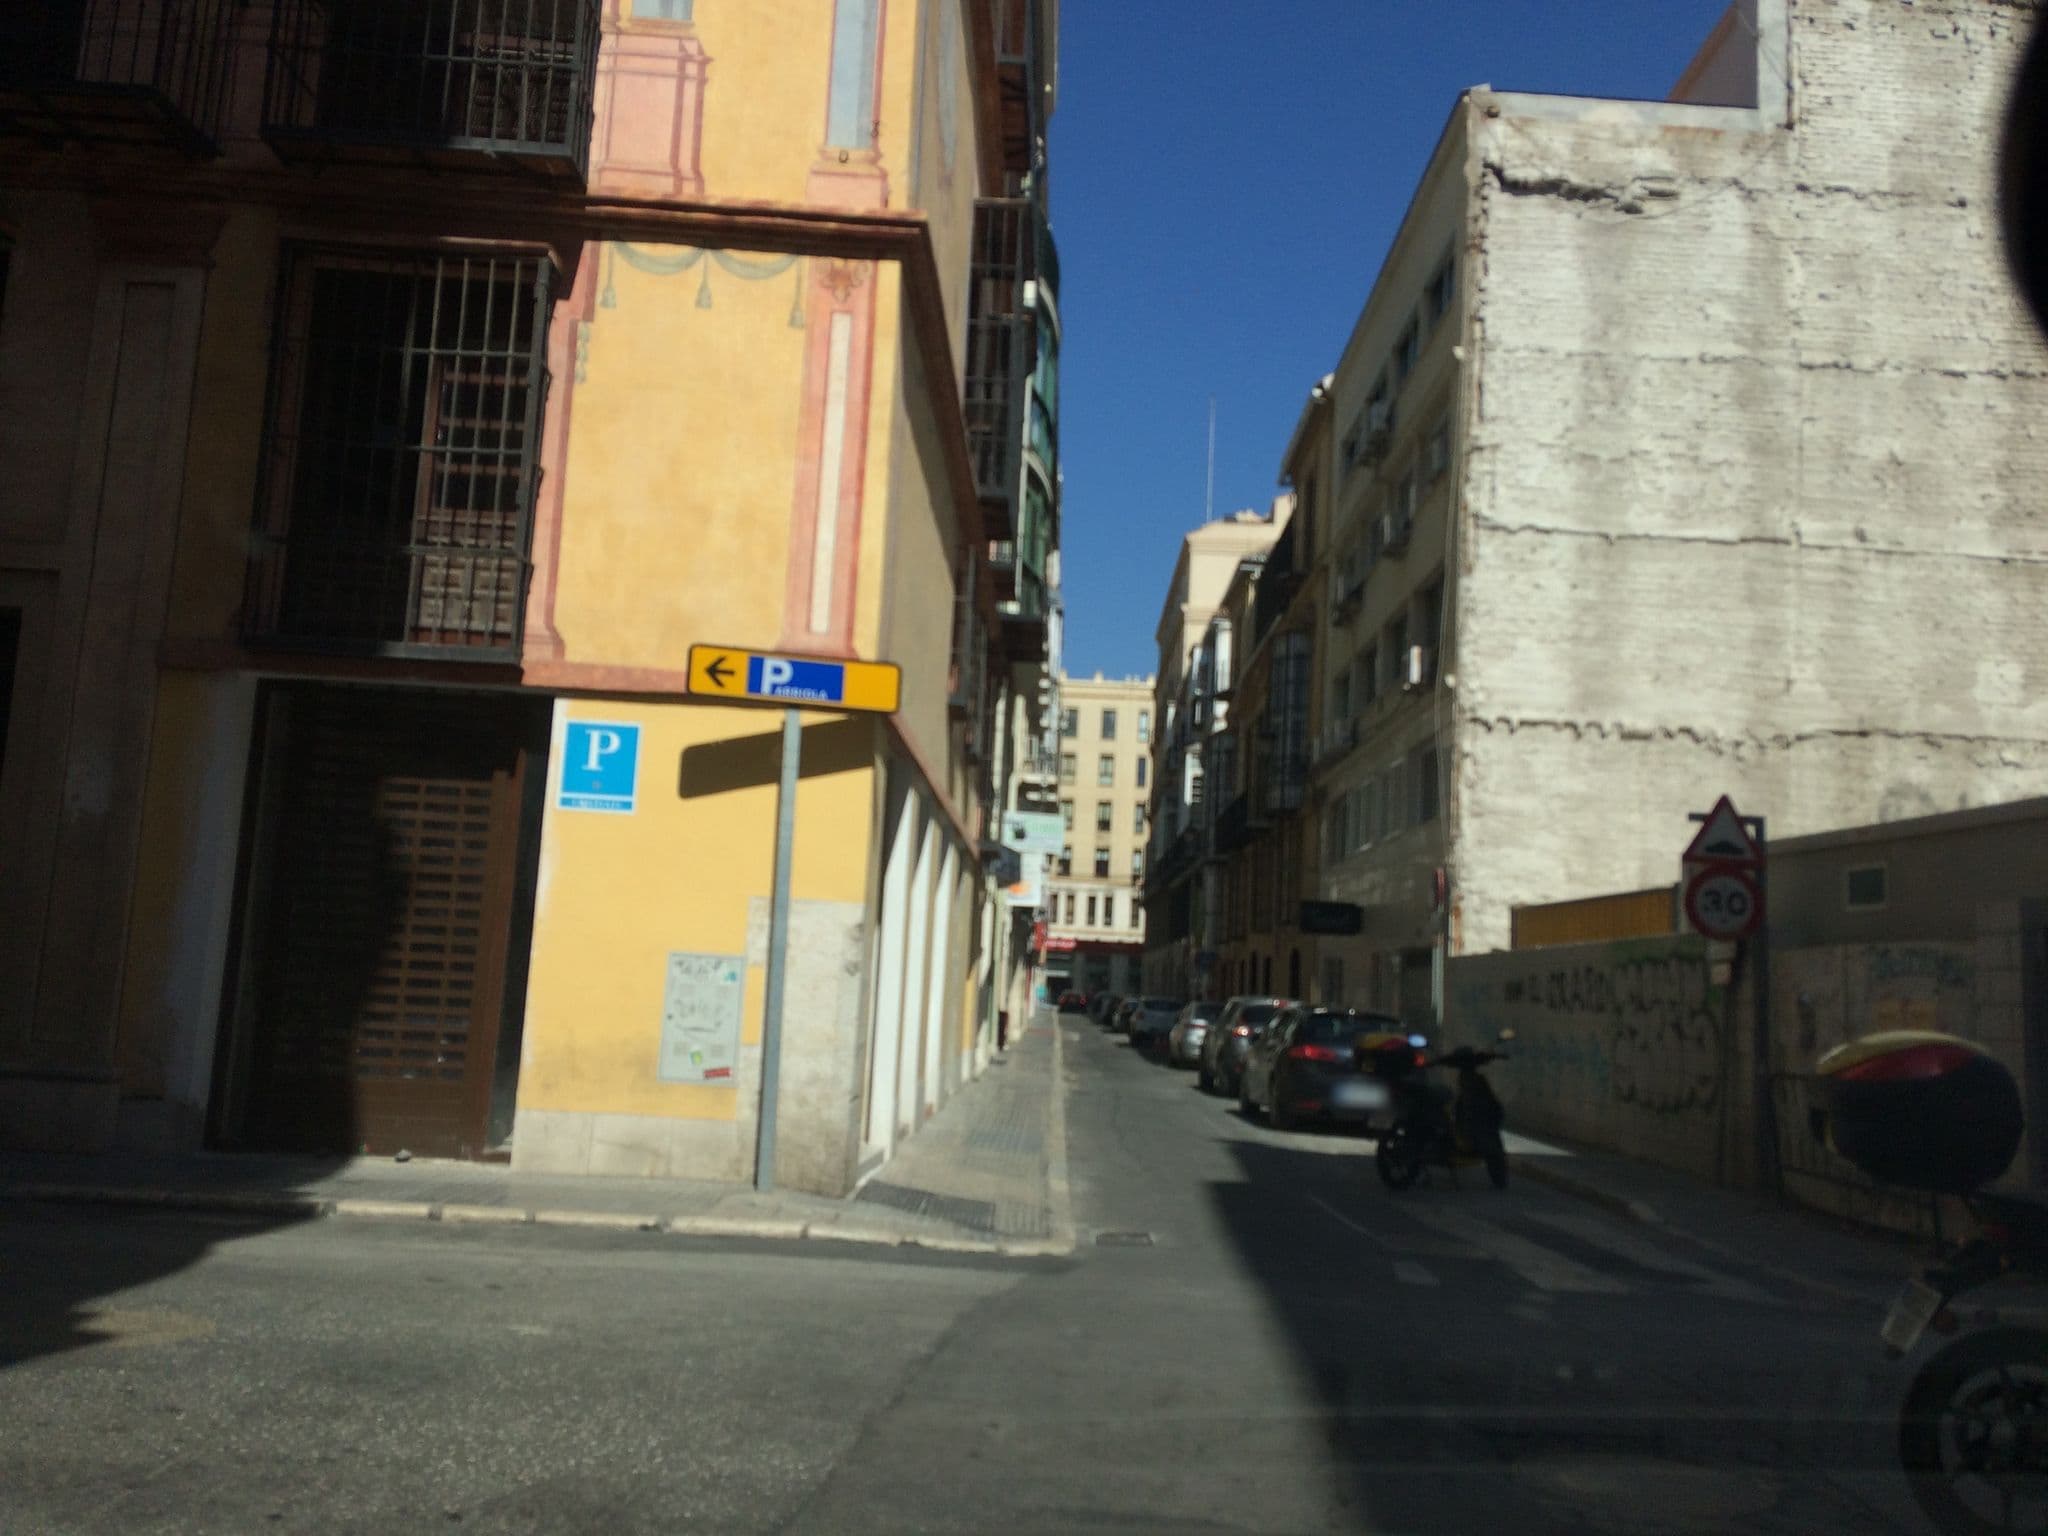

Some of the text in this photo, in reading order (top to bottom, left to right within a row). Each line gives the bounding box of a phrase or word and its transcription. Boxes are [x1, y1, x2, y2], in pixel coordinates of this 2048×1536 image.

[760, 657, 793, 696] P
[581, 728, 621, 772] P
[1703, 889, 1749, 917] 30
